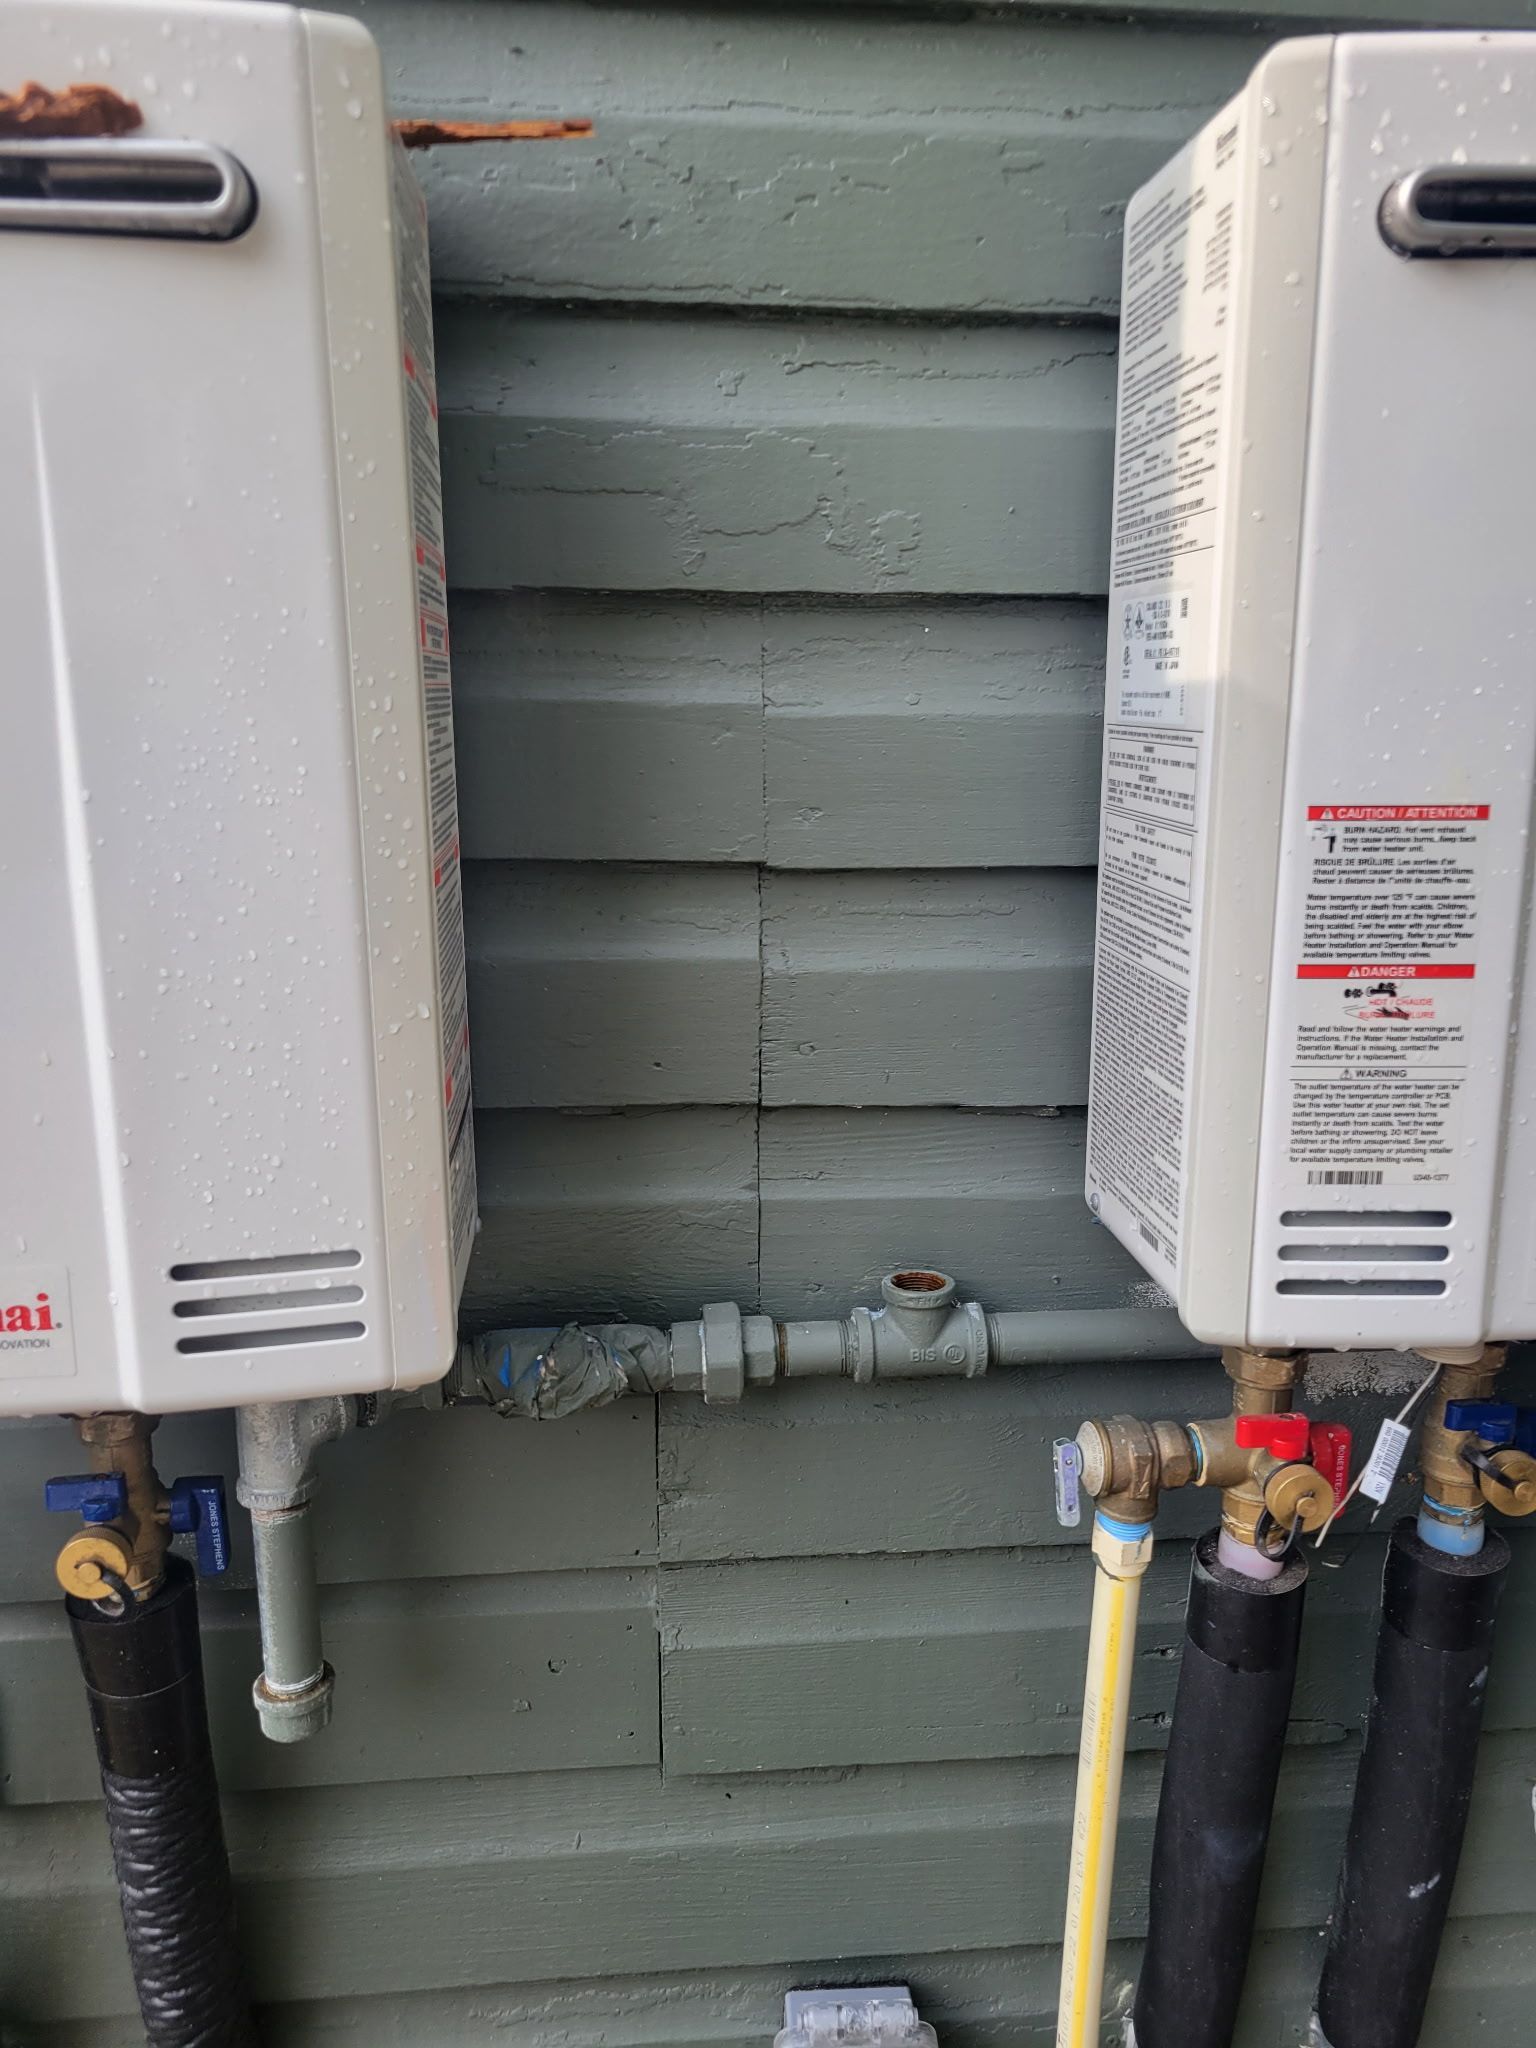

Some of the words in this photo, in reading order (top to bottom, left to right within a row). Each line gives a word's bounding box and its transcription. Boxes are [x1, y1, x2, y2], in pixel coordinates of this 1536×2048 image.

[1336, 808, 1396, 819] CAUTION
[1405, 806, 1478, 818] ATTENTION
[1360, 966, 1417, 977] DANGER
[1356, 1069, 1407, 1078] WARNING
[0, 1338, 50, 1350] OVATION
[208, 1500, 219, 1527] JONES
[211, 1527, 225, 1570] STEPHENS
